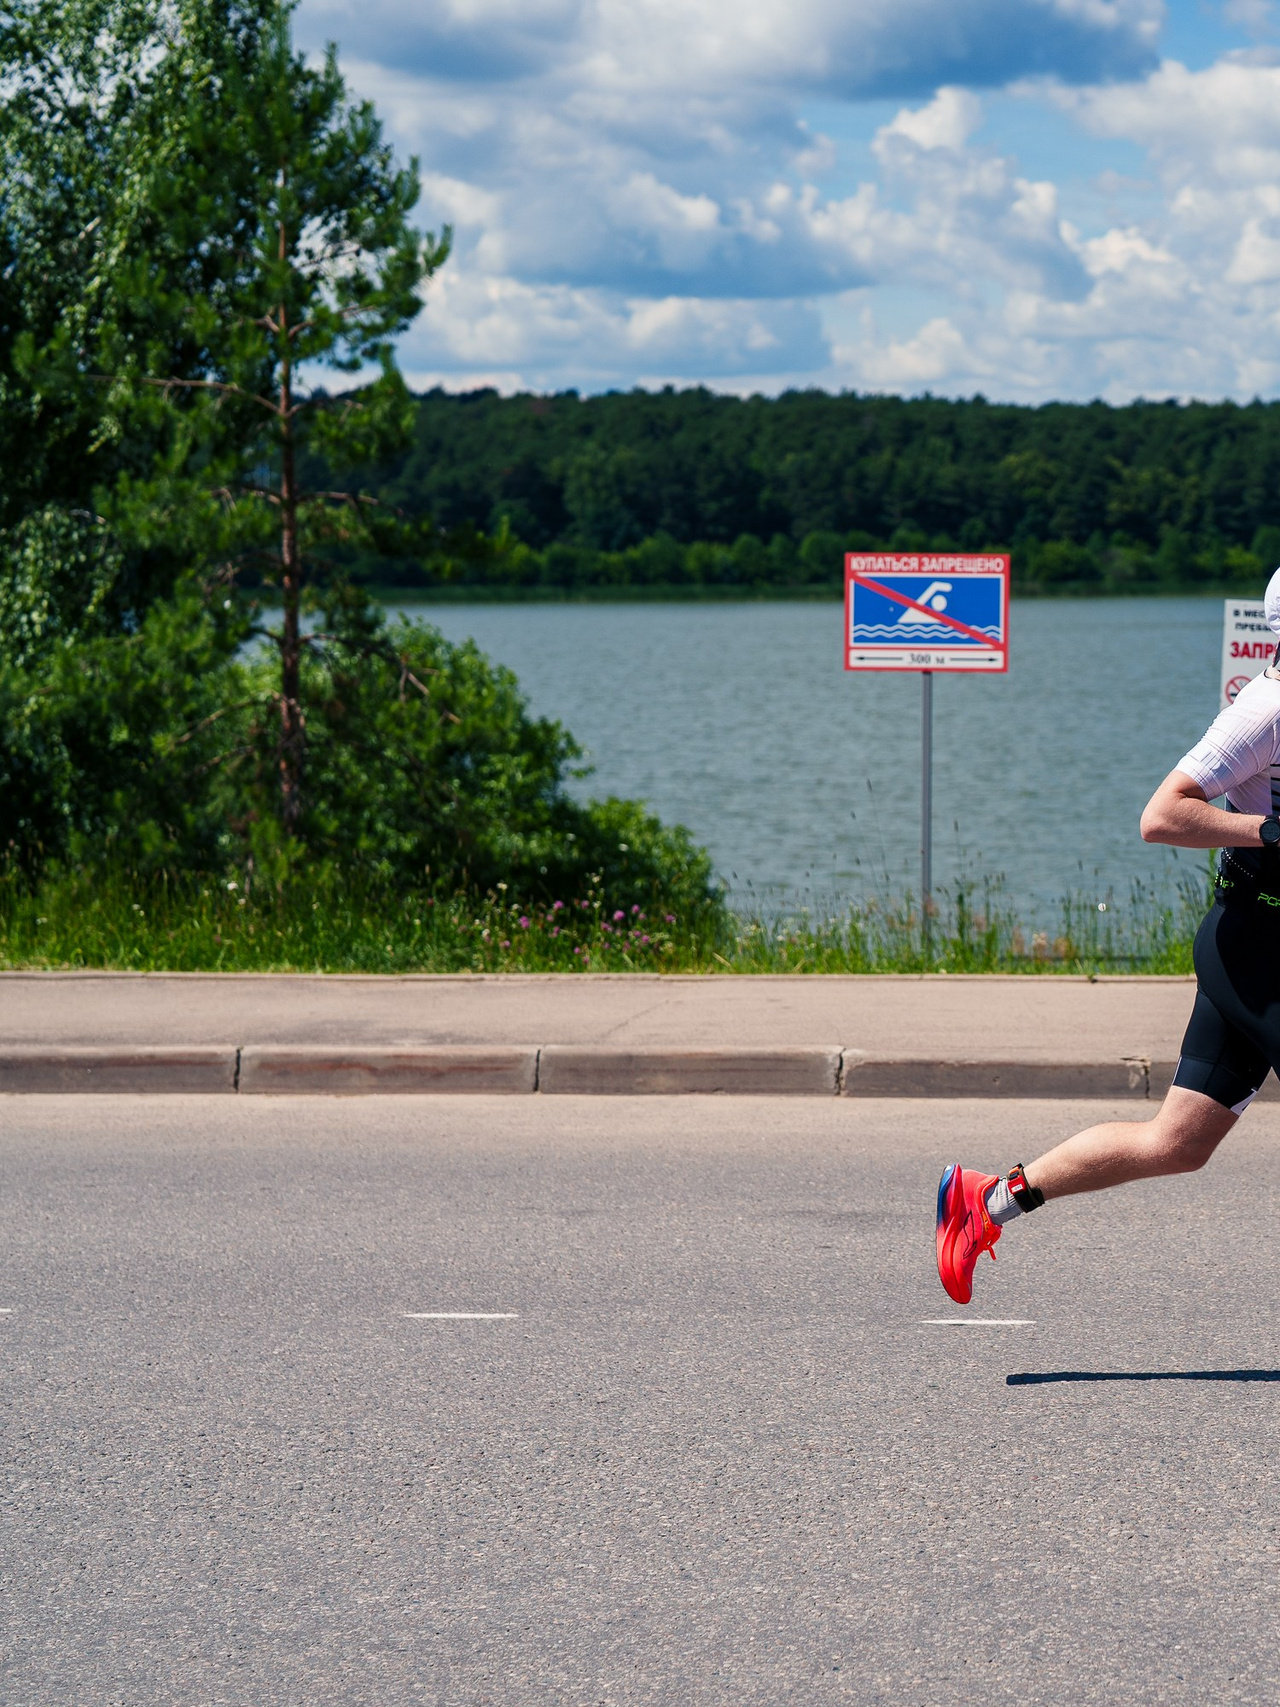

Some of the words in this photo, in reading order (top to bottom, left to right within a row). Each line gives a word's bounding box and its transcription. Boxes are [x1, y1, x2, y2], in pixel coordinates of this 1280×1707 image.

[851, 556, 919, 571] КУПАТЬСЯ
[921, 557, 1004, 573] ЗАПРЕЩЕНО
[1244, 610, 1266, 618] МЕС
